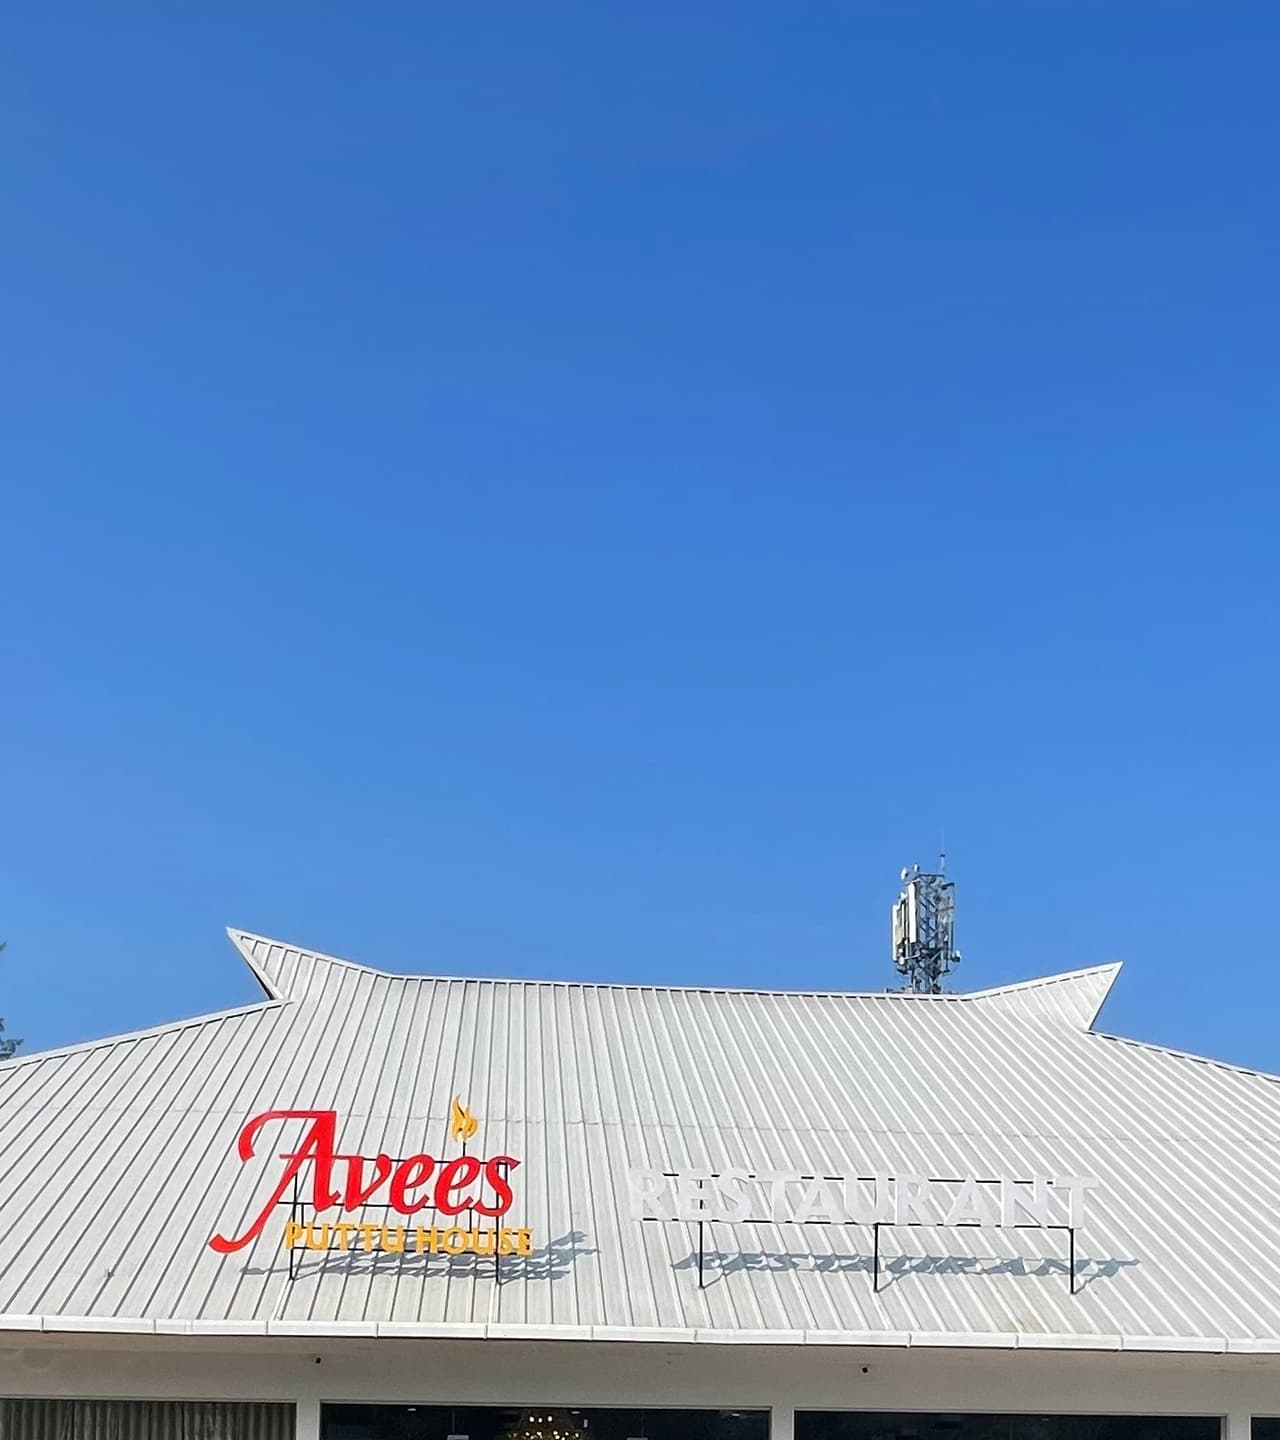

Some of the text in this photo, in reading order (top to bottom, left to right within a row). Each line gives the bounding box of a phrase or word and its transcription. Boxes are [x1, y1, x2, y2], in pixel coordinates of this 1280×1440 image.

[209, 1110, 521, 1253] Avees
[631, 1169, 1100, 1230] RESTAURANT
[285, 1221, 534, 1258] PUTTU HOUSE
